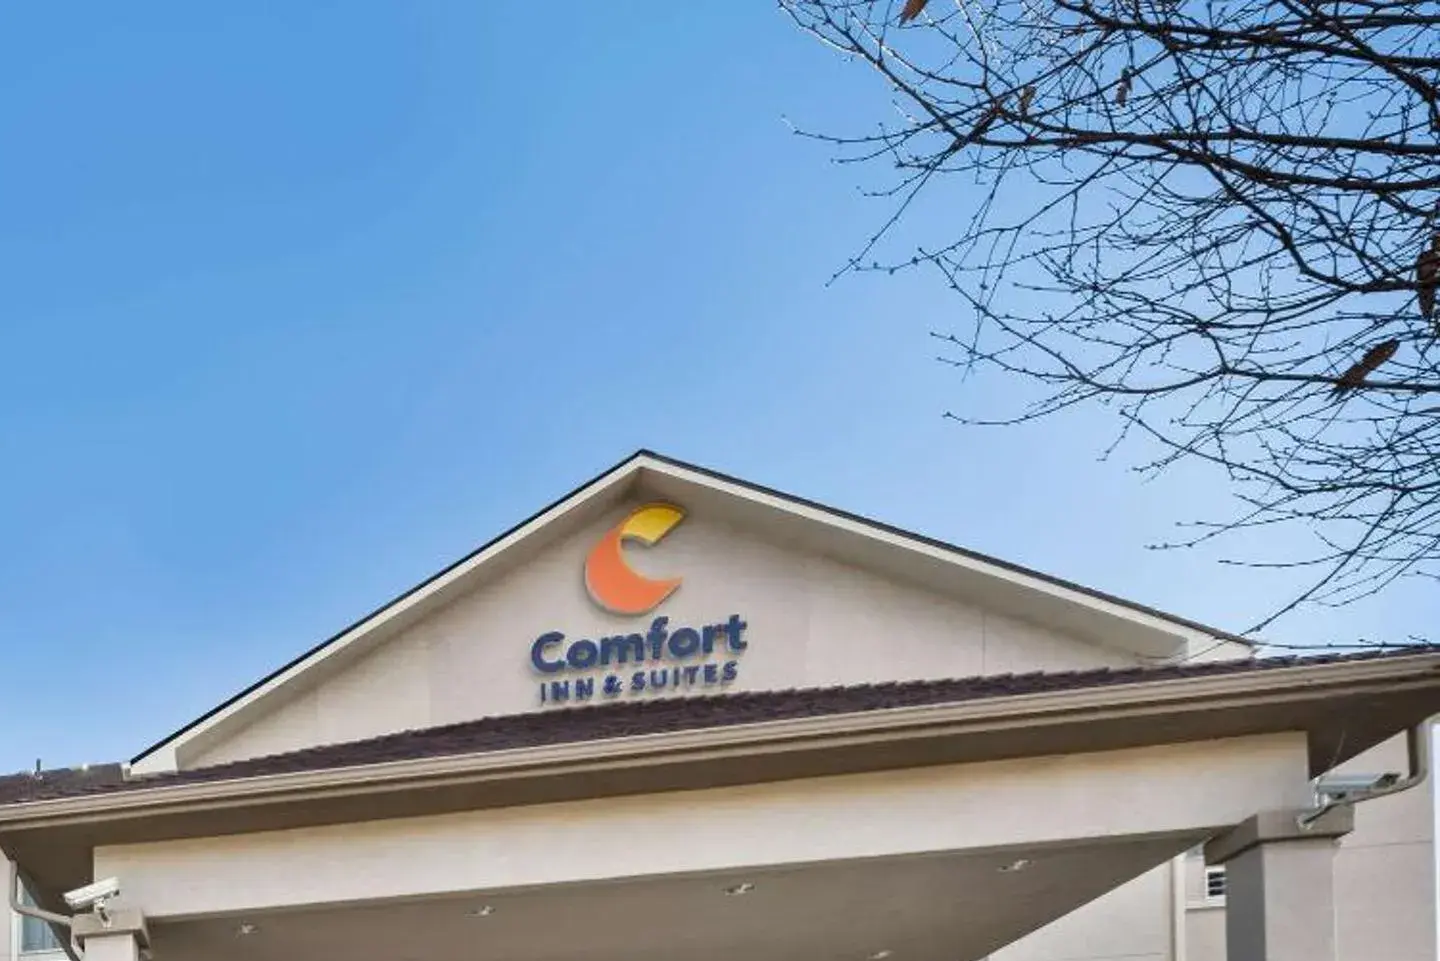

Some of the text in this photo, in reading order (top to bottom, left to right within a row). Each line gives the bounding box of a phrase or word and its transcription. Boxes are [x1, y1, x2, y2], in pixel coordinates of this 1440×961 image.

[531, 614, 747, 673] Comfort
[540, 660, 738, 704] INN & SUITES
